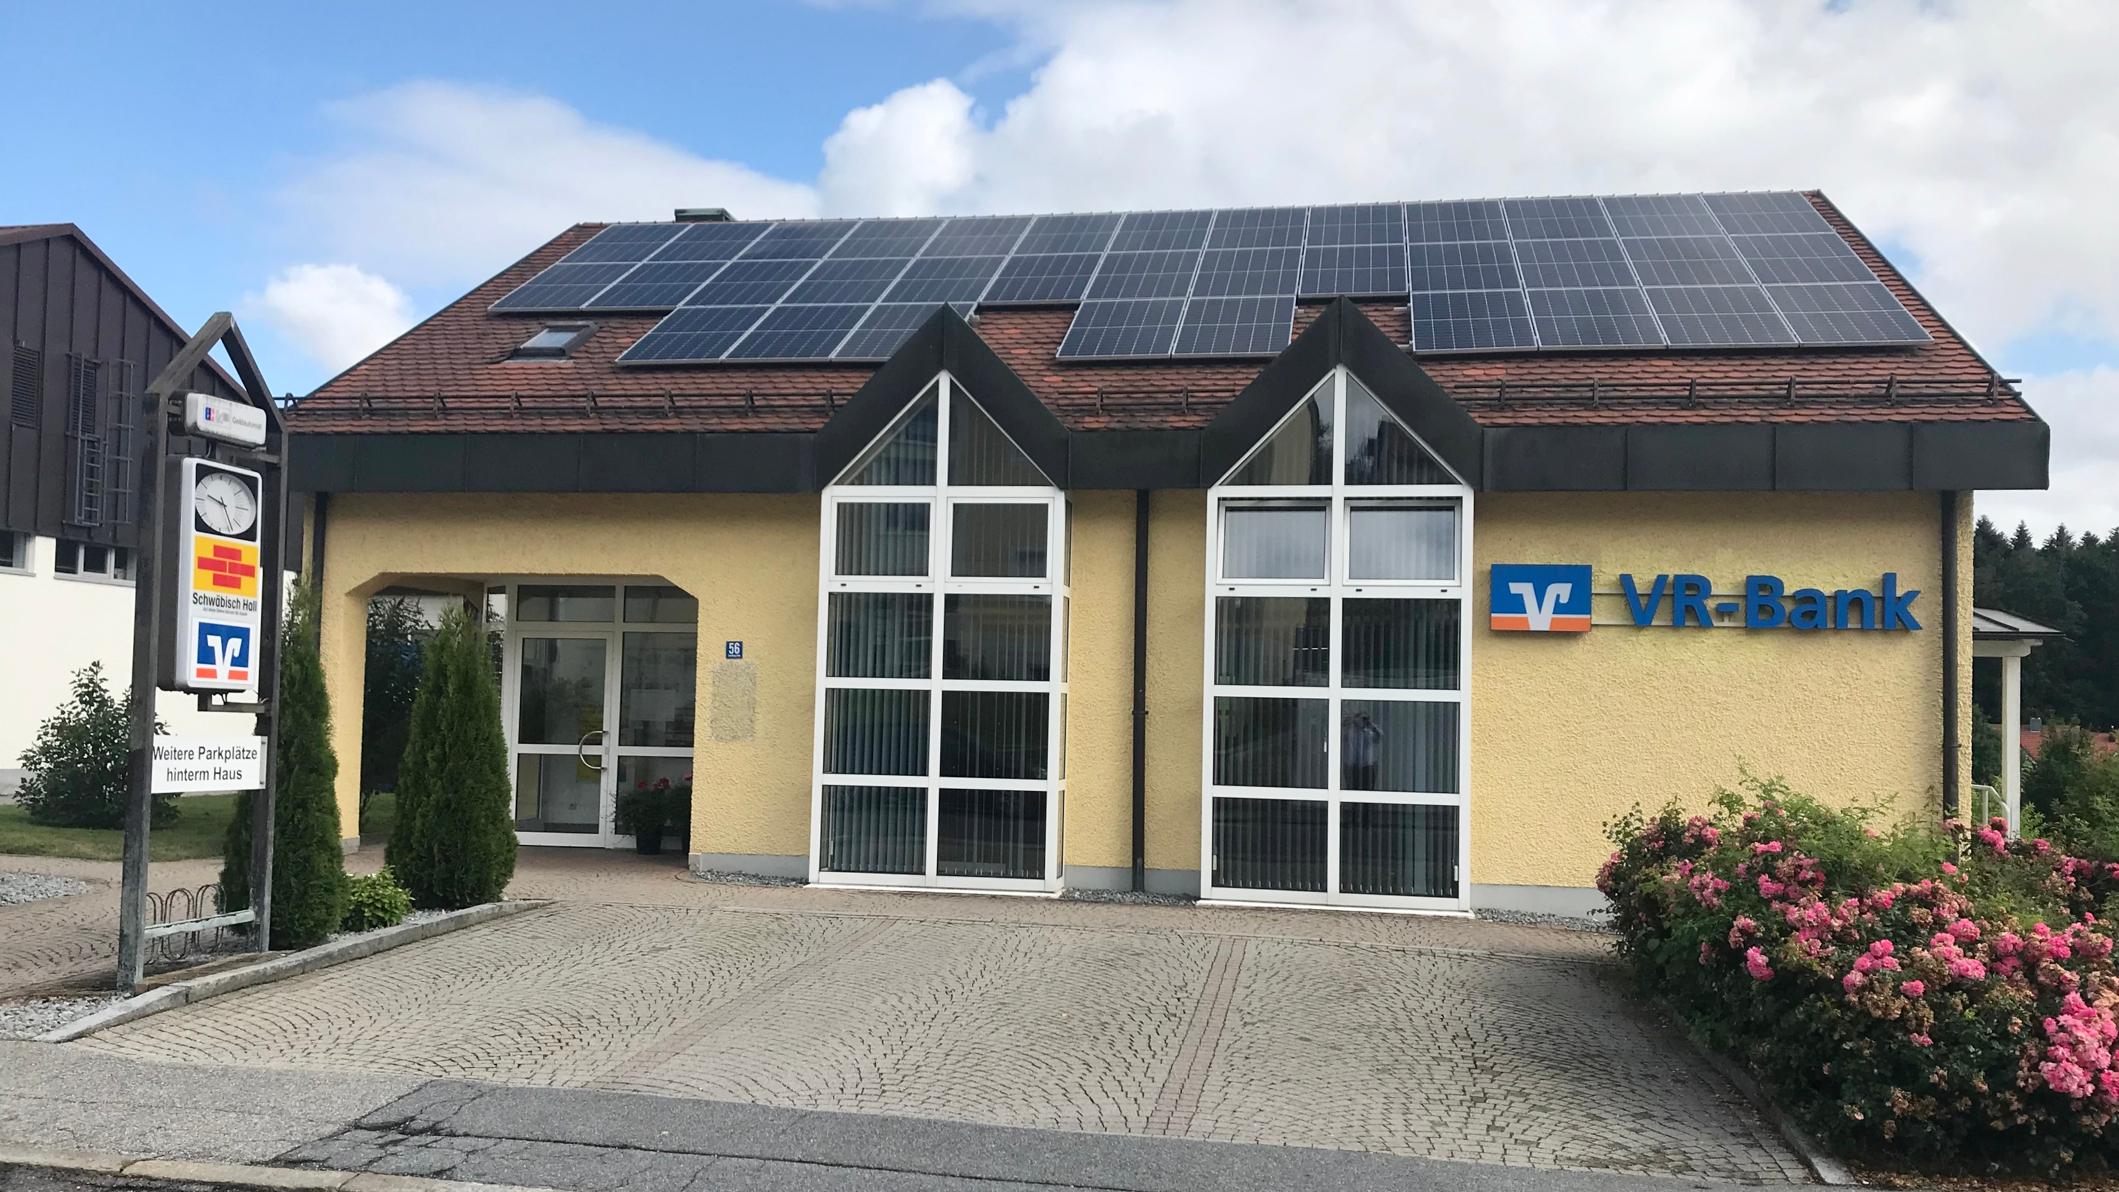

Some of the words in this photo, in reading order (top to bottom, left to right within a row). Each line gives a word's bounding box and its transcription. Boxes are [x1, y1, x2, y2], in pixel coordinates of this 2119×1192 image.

[1619, 572, 1922, 630] VR-Bank
[728, 642, 740, 654] 56
[153, 746, 195, 760] Weitere
[198, 746, 258, 763] Parkplätze
[166, 767, 210, 782] hinterm
[213, 767, 243, 780] Haus
